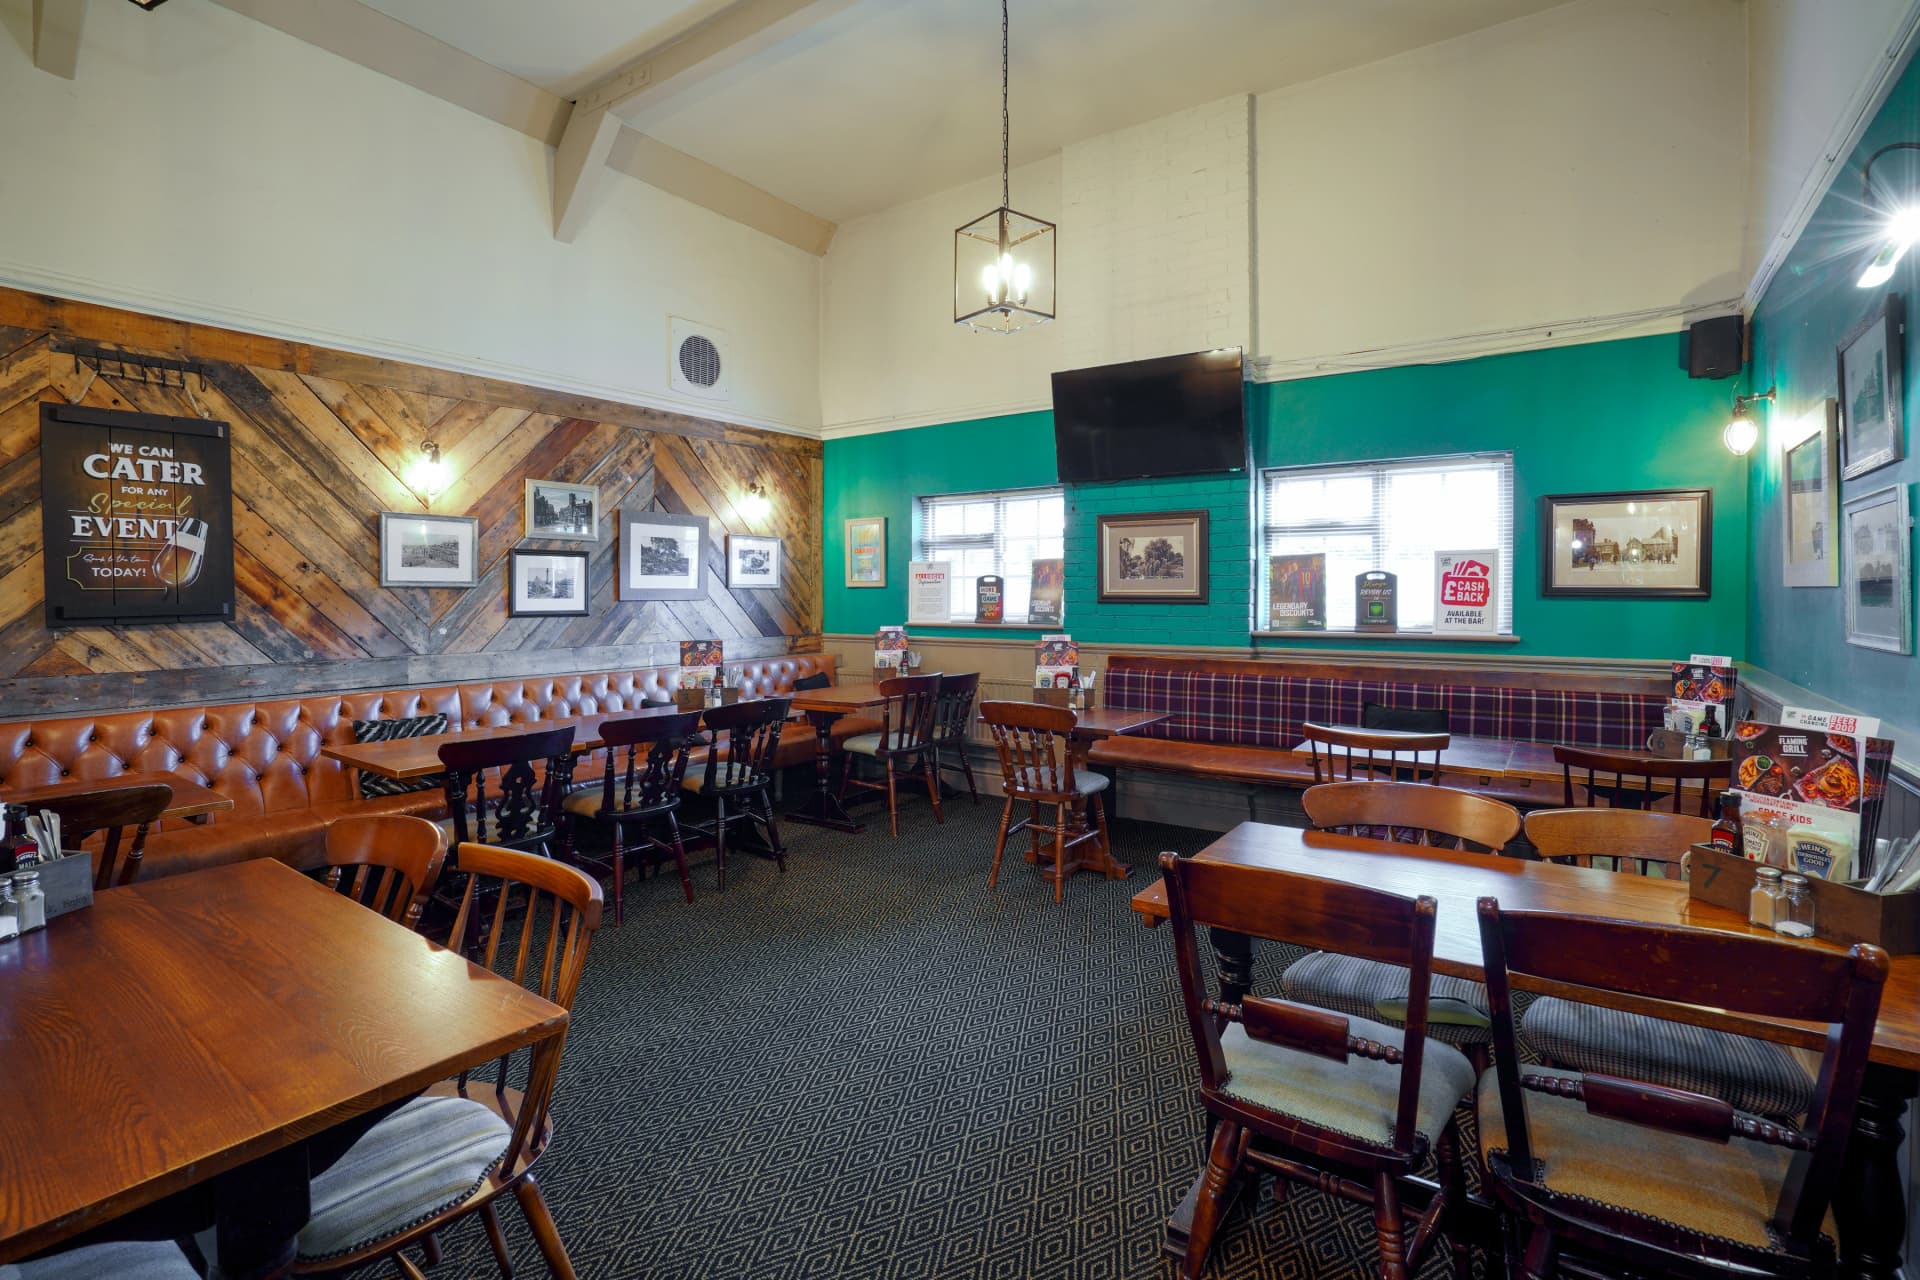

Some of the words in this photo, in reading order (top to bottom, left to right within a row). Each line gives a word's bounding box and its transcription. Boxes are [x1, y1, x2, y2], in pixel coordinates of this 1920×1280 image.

[108, 443, 133, 454] WE
[138, 446, 174, 459] CAN
[82, 453, 206, 485] CATER
[120, 486, 144, 496] FOR
[147, 487, 169, 496] ANY
[87, 492, 192, 515] Special
[71, 515, 180, 539] EVENT
[91, 567, 146, 577] TODAY!
[1457, 581, 1485, 592] CASH
[1457, 591, 1484, 602] BACK
[1272, 601, 1309, 610] LEGENDARY
[1279, 608, 1315, 617] DISCOUNTS
[1447, 610, 1483, 618] AVAILABLE
[1807, 714, 1827, 722] GAME
[1829, 714, 1855, 726] BEER
[1829, 723, 1855, 734] FOOD
[1778, 738, 1807, 746] FLAMING
[1782, 744, 1806, 754] GRILL
[1790, 813, 1813, 825] KIDS
[1702, 864, 1722, 889] 7
